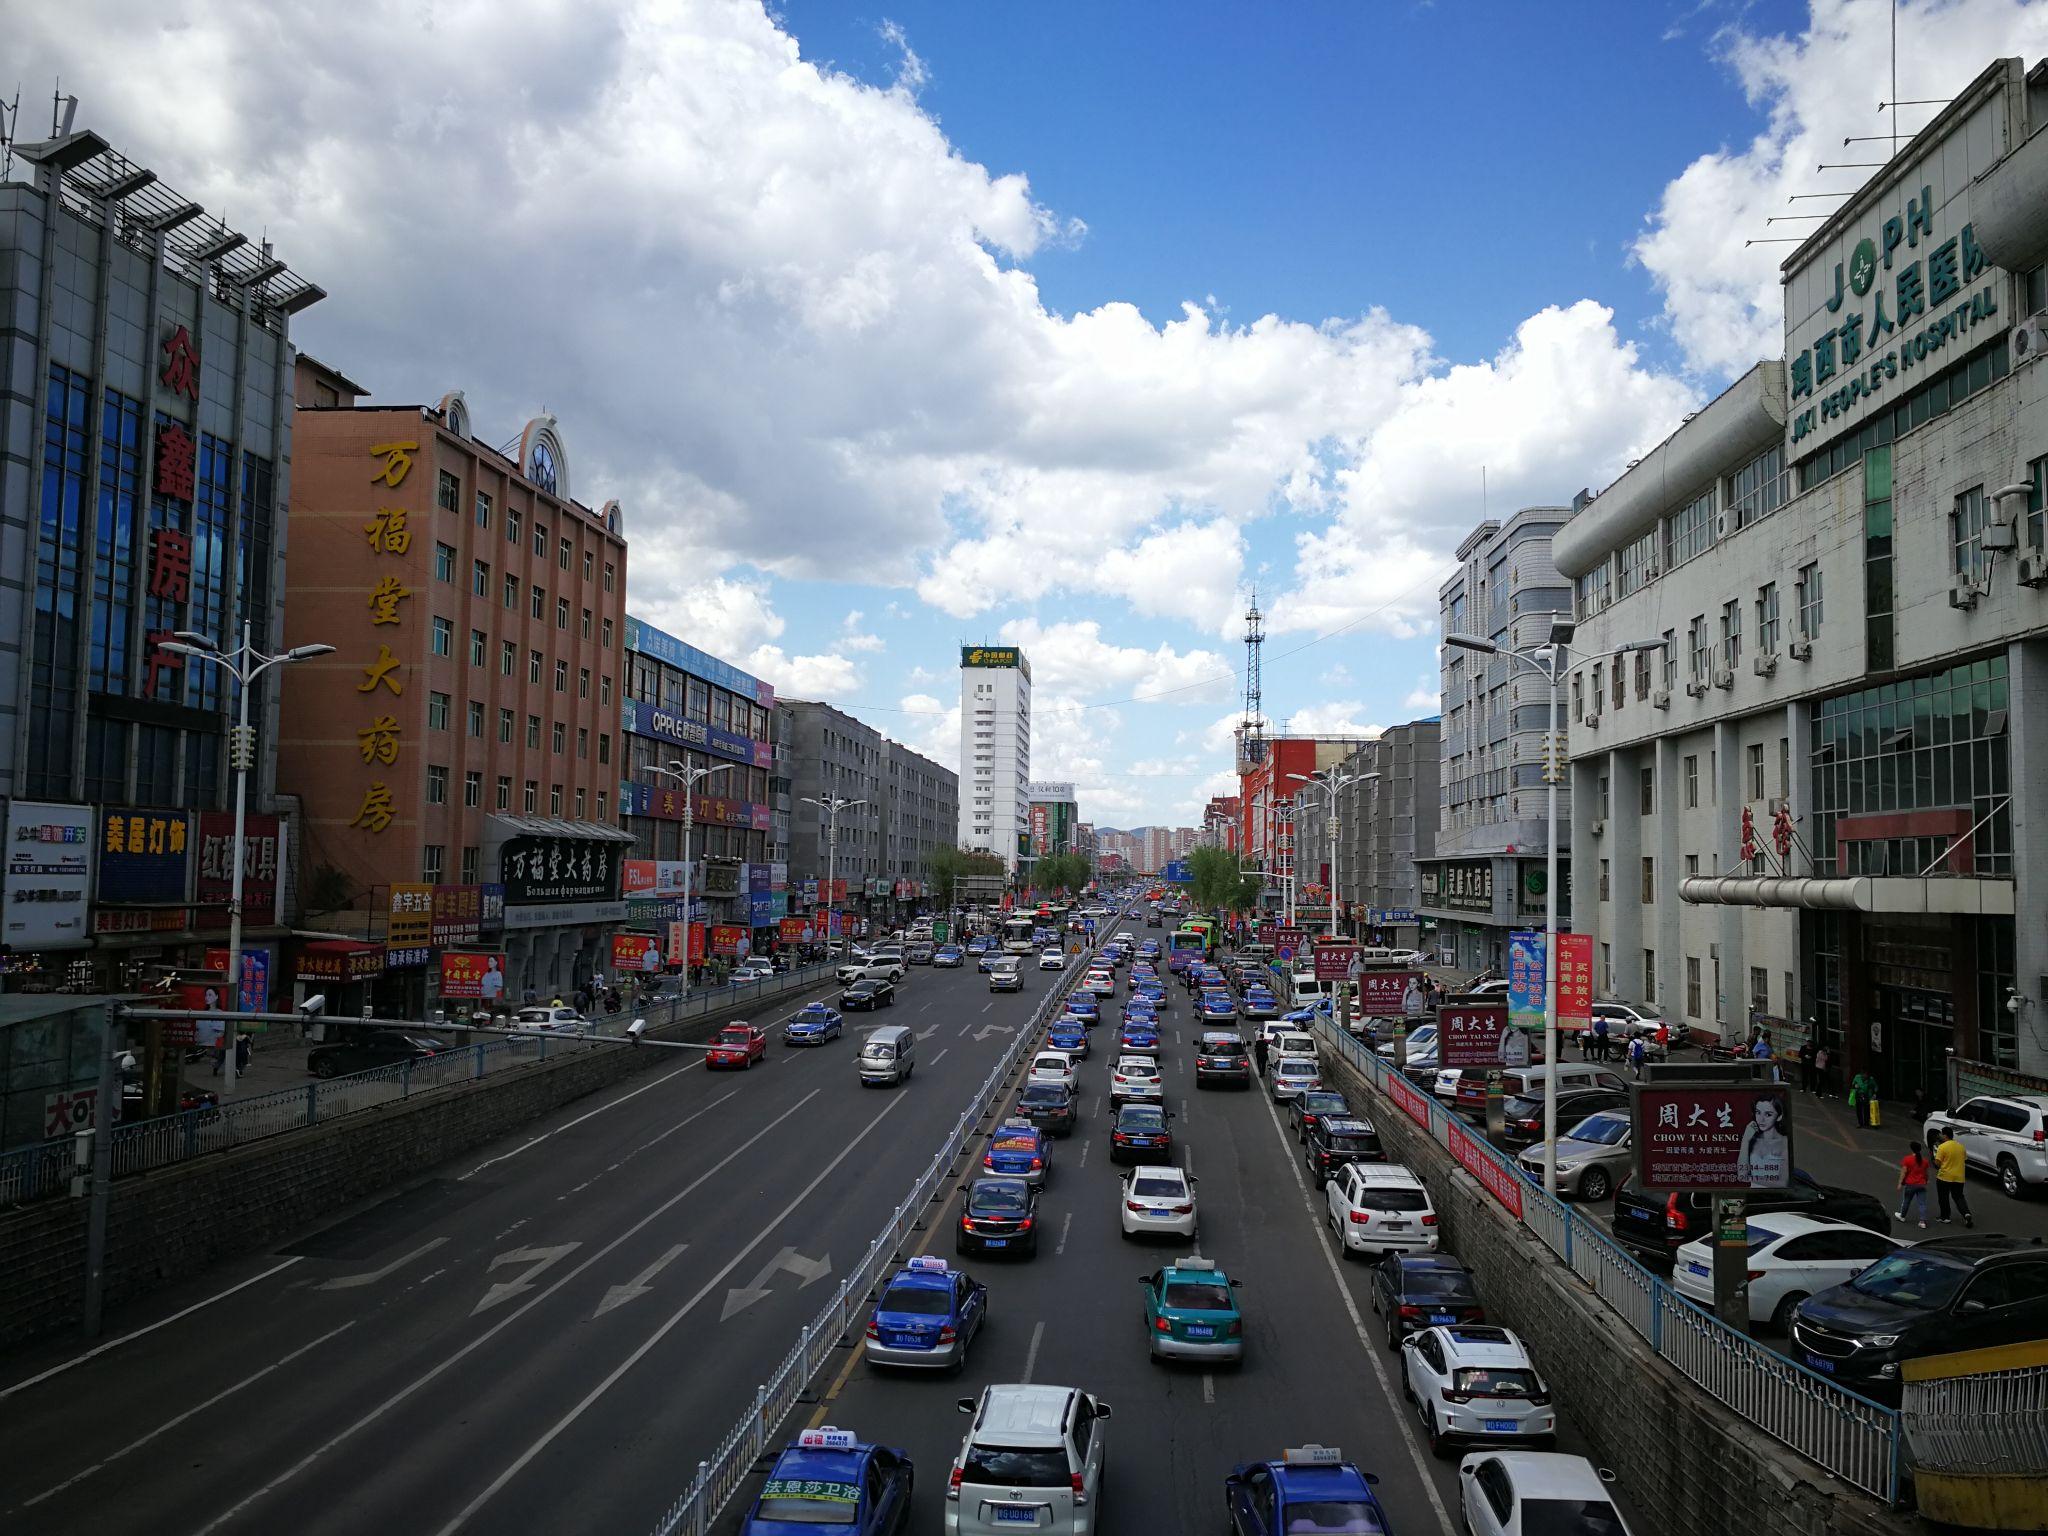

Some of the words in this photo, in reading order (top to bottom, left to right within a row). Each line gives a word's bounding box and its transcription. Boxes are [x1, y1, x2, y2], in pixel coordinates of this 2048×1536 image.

[1901, 286, 1998, 371] HOSPITAL
[143, 325, 200, 697] 众鑫房产
[349, 440, 419, 832] 万福堂大药房
[983, 651, 1014, 659] 中国邮政
[652, 711, 682, 739] OPPLE
[664, 791, 725, 821] 美灯饰
[106, 815, 186, 855] 美居灯饰
[512, 847, 608, 882] 万福堂大药房
[629, 869, 640, 886] FSL
[97, 913, 149, 931] 美居灯饰
[1321, 951, 1347, 961] 周大生
[1368, 978, 1400, 990] 周大生
[1560, 950, 1572, 995] 中国黄金
[1576, 962, 1588, 1007] 买的放心
[1451, 1016, 1496, 1031] 周大生
[1658, 1102, 1734, 1128] 周大生
[1653, 1133, 1685, 1142] CHOW
[1690, 1133, 1708, 1142] TAI
[1712, 1133, 1739, 1142] SENG
[804, 1434, 823, 1445] 出租
[764, 1480, 861, 1500] 法恩莎卫浴
